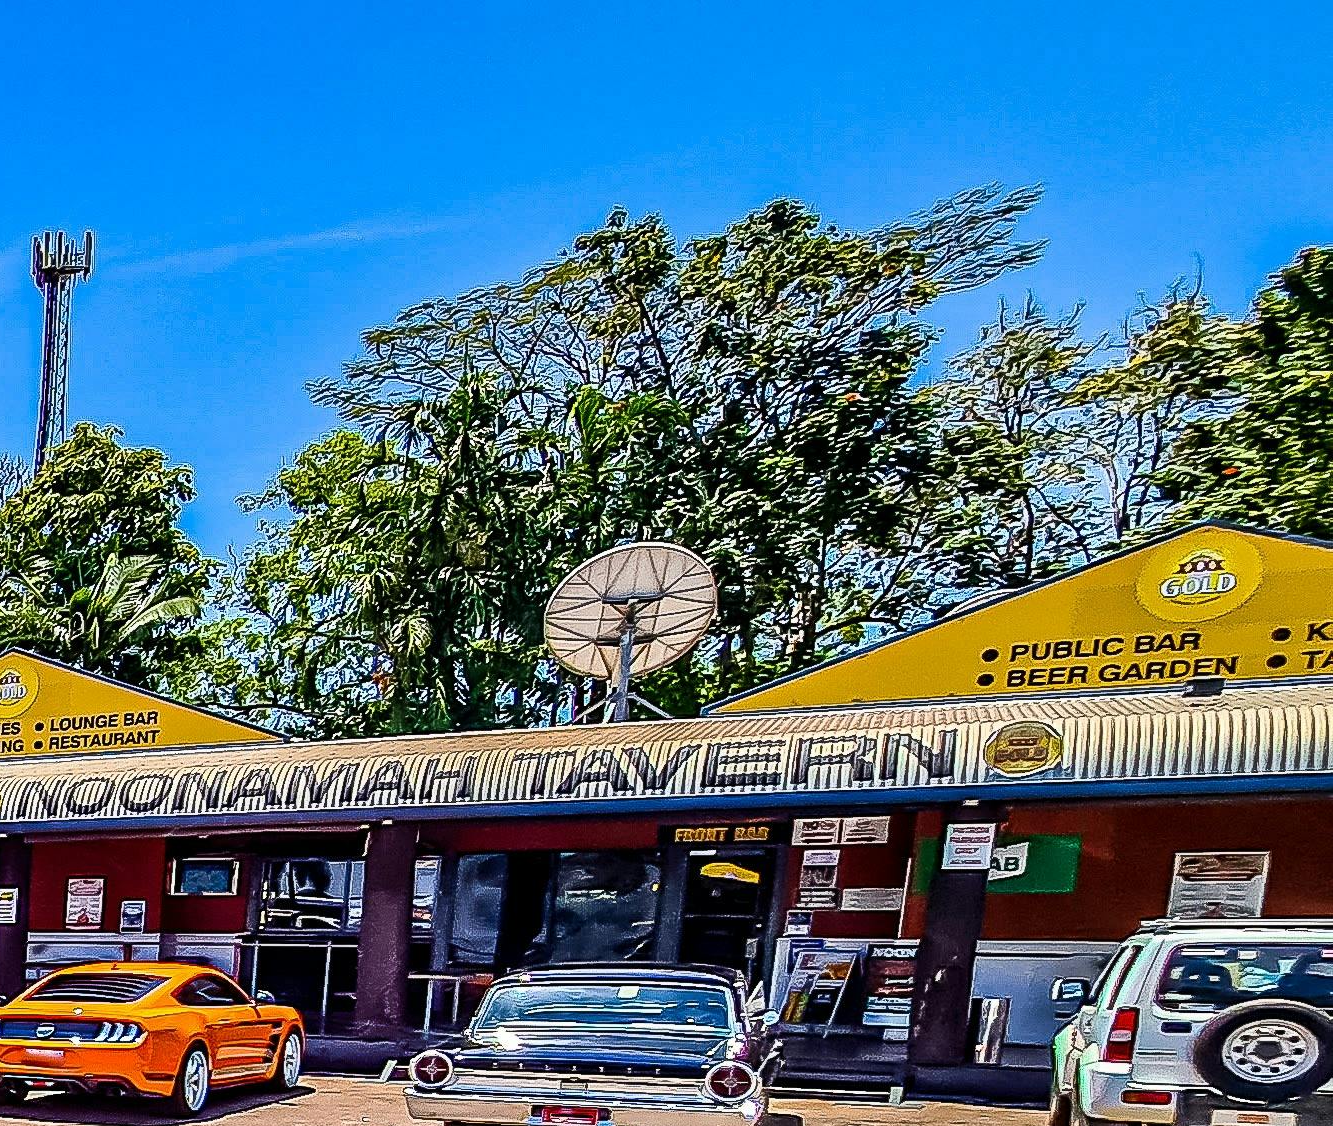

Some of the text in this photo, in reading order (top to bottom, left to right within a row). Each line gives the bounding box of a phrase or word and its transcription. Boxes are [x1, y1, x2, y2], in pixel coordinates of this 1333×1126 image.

[1159, 571, 1237, 599] GOLD
[1009, 631, 1202, 662] PUBLIC BAR
[1006, 656, 1239, 688] BEER GARDEN
[50, 711, 158, 732] LOUNGE BAR
[48, 730, 161, 750] RESTAURANT
[17, 730, 959, 819] NOONAMAH TAVERN
[675, 826, 770, 843] FRONT BAR
